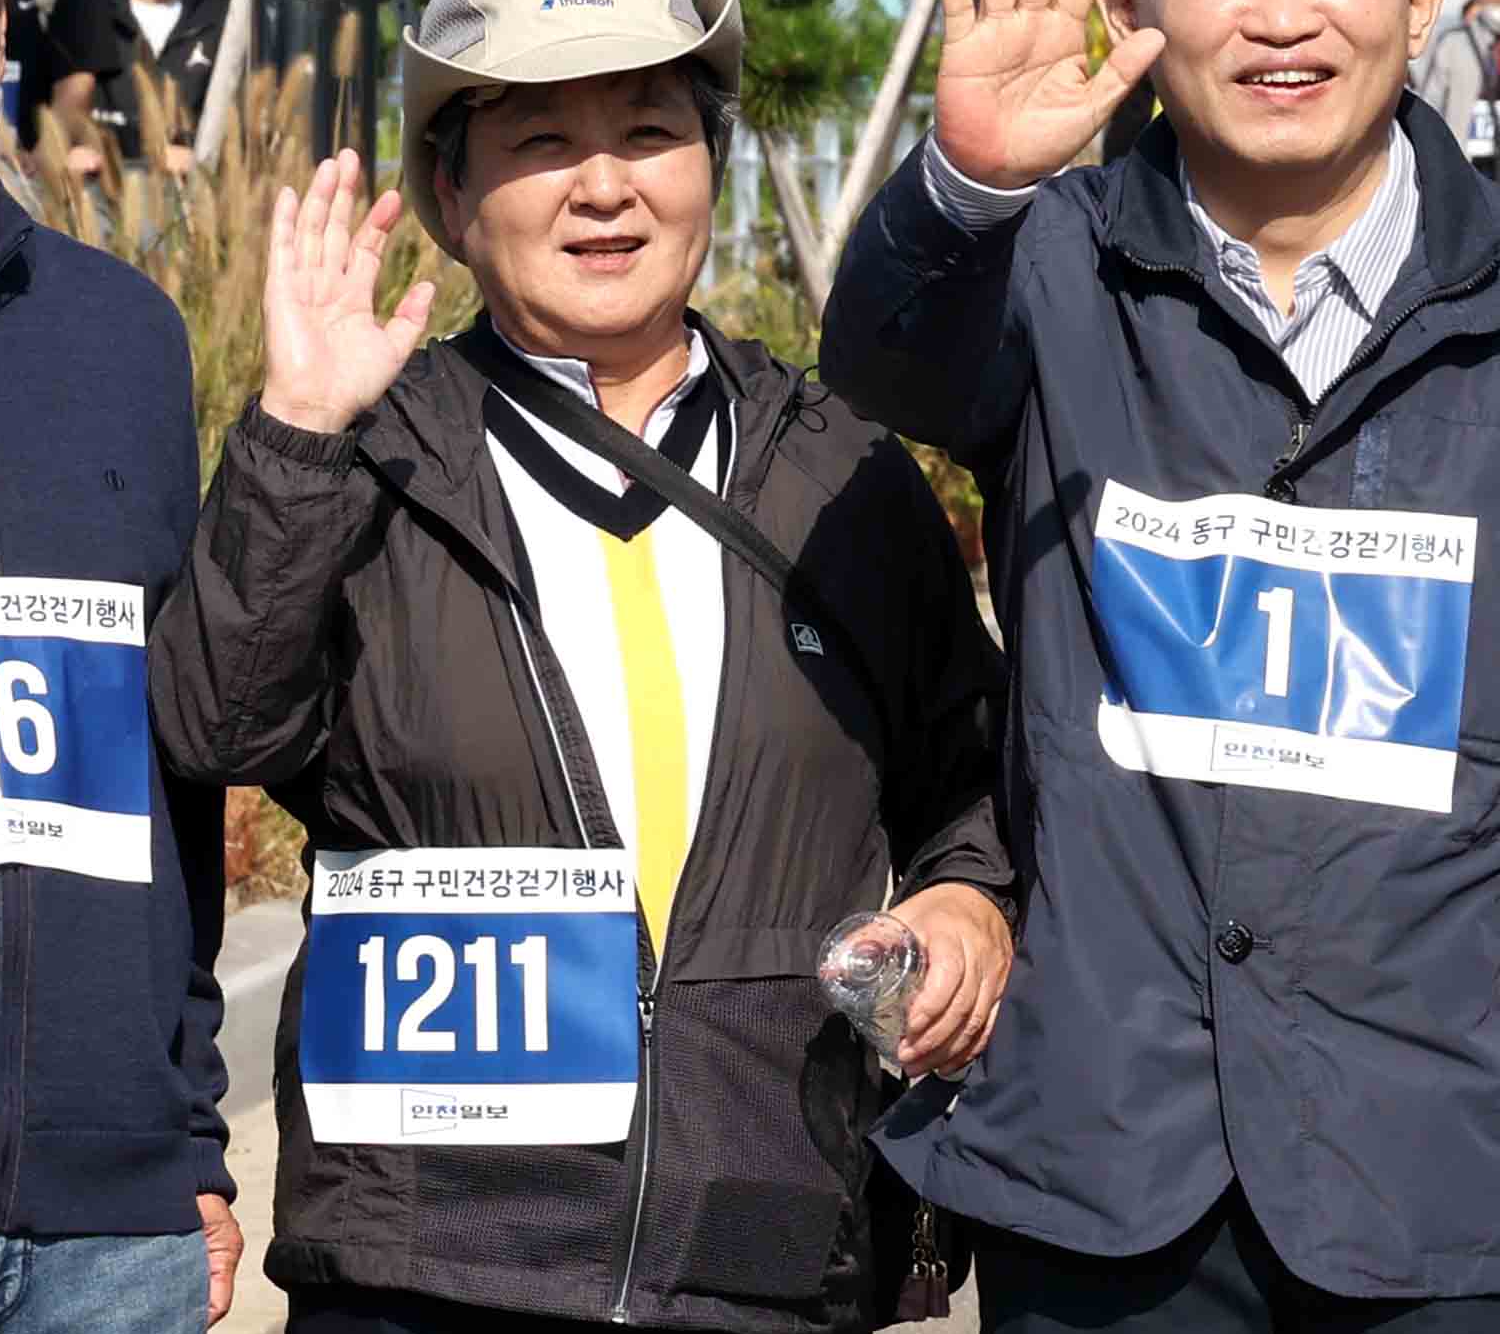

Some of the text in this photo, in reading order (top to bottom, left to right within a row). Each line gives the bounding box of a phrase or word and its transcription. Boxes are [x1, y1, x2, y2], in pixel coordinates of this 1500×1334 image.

[1114, 506, 1465, 567] 2024 동구 구민건강걷기행사
[1257, 587, 1294, 698] 1
[1224, 742, 1325, 770] 인천일보
[327, 868, 625, 898] 2024 동구 구민건강걷기행사
[359, 934, 549, 1052] 1211
[411, 1104, 509, 1119] 인천일보
